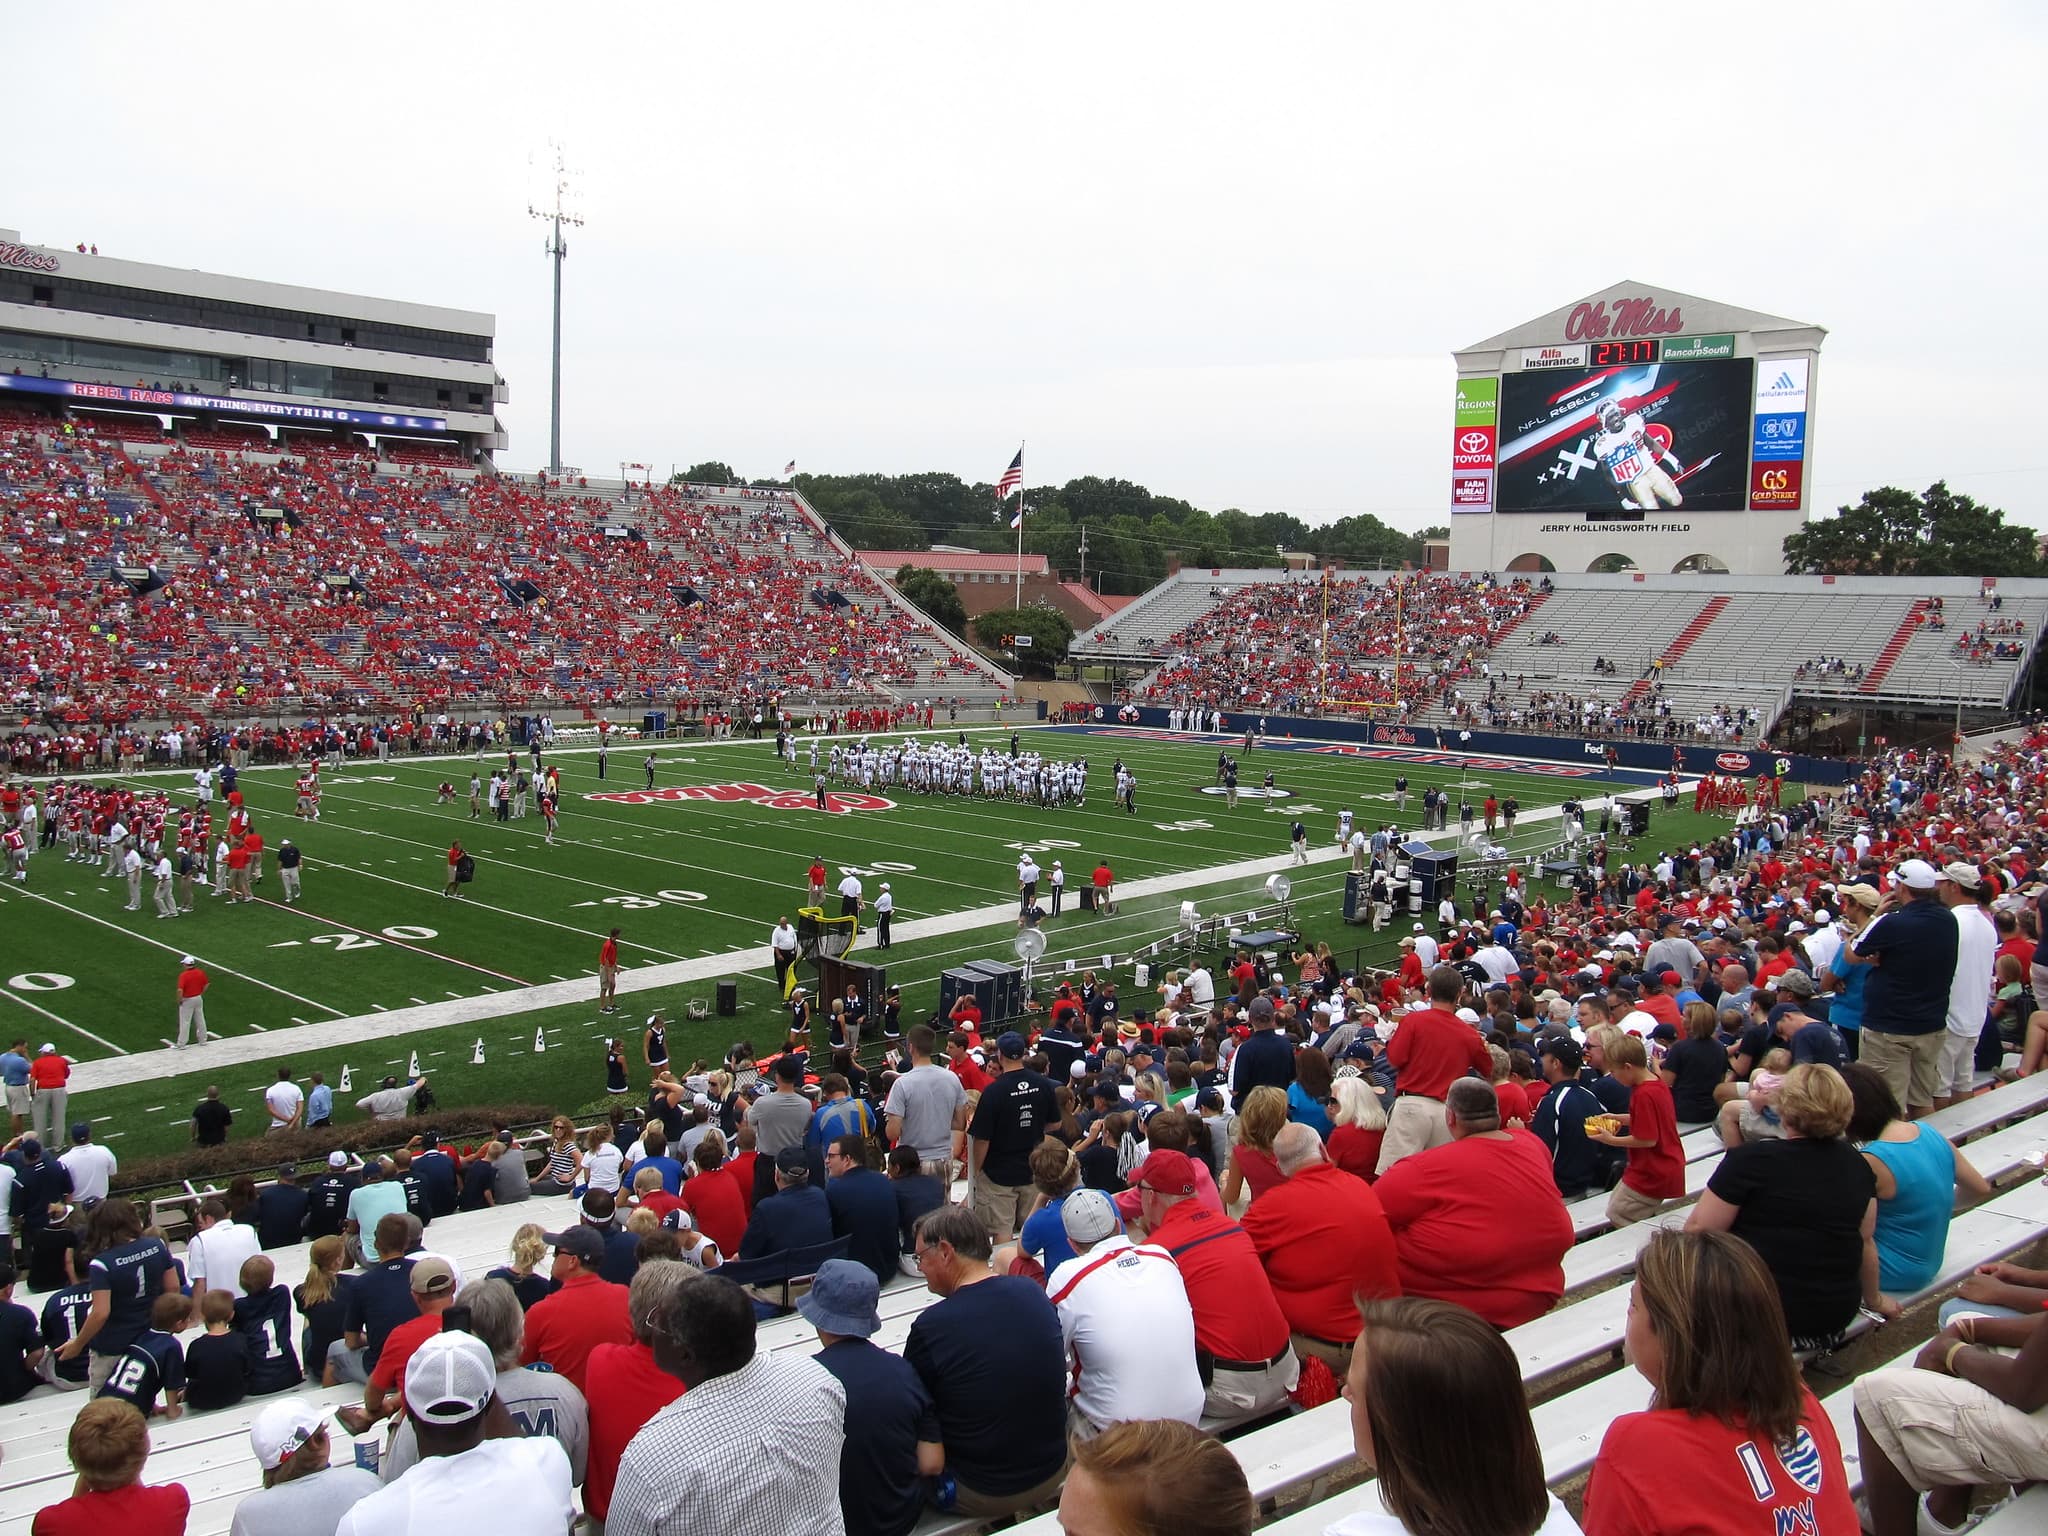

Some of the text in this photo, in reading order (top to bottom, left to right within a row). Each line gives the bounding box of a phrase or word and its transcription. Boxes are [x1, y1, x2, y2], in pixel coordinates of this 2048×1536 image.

[1565, 297, 1684, 342] Ole Miss
[1540, 348, 1562, 359] Alfa
[1597, 341, 1652, 364] 27:17
[1663, 345, 1731, 358] BancorpSouth
[1525, 356, 1580, 368] Insurance
[75, 384, 126, 400] REBEL
[130, 390, 174, 404] RAGS
[1518, 391, 1600, 432] NFL REBELS
[1454, 454, 1493, 464] TOYOTA
[1613, 462, 1641, 481] NFL
[1762, 469, 1788, 490] GS
[1456, 487, 1486, 496] BUREAU
[1464, 480, 1485, 488] FARM
[1752, 489, 1798, 500] GOLD STRIKE
[1540, 524, 1690, 532] JERRY HOLLINGSWORTH FIELD
[310, 926, 439, 951] 20
[115, 1246, 160, 1266] COUGARS
[135, 1265, 146, 1299] 1
[262, 1318, 283, 1359] 1
[108, 1354, 146, 1394] 12
[1736, 1441, 1775, 1502] I
